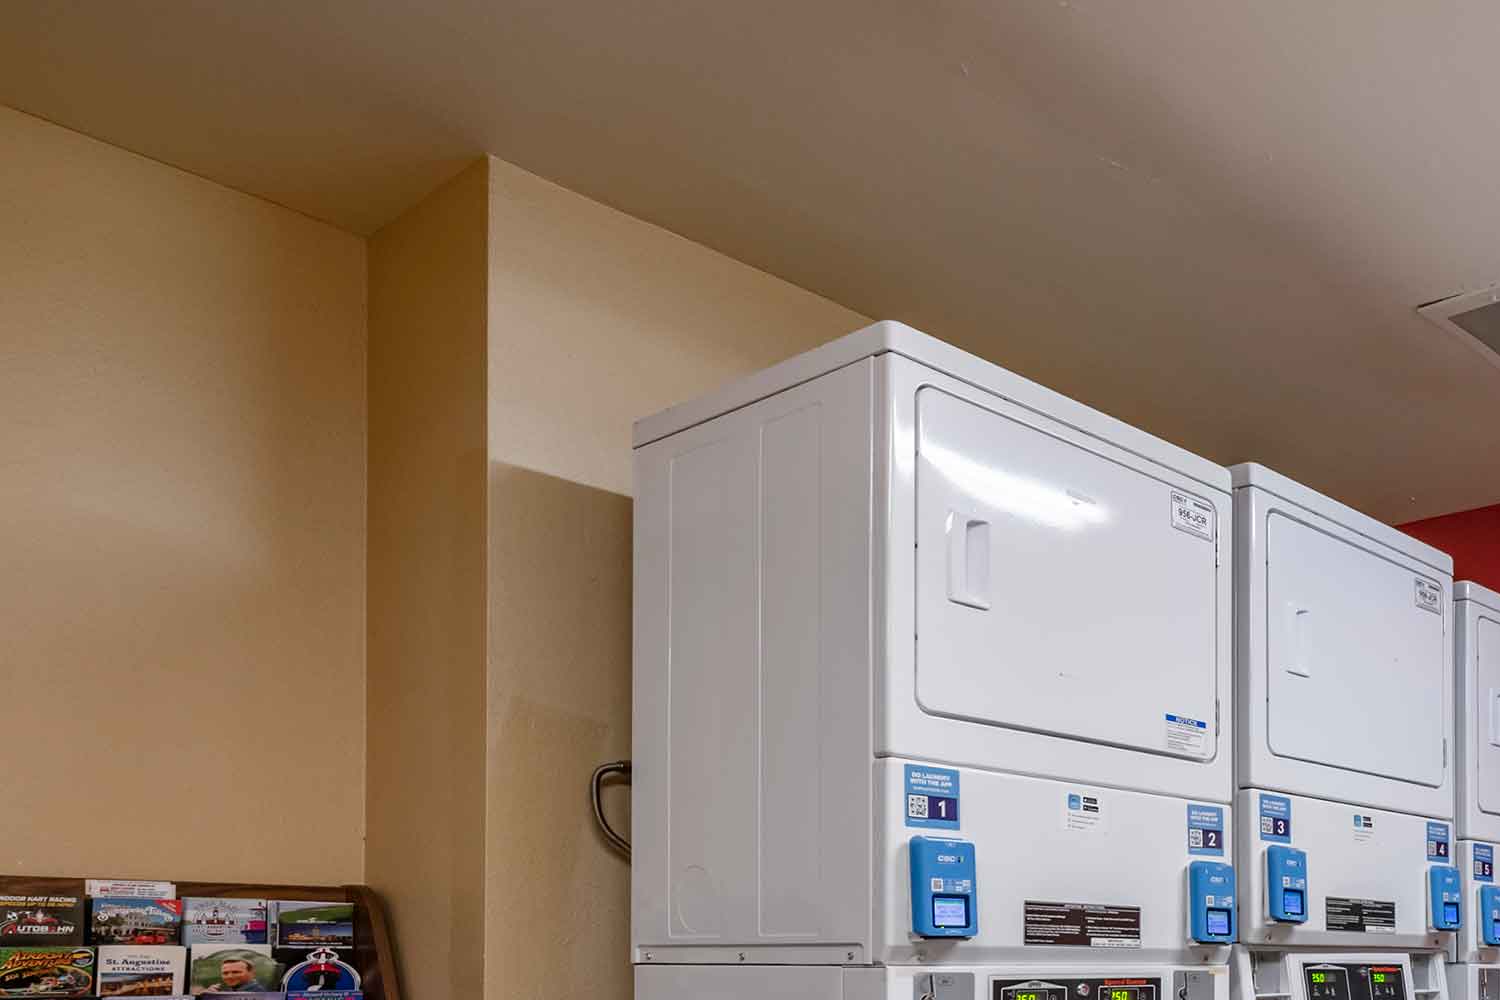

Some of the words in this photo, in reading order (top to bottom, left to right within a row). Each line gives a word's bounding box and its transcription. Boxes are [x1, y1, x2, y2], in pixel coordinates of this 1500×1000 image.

[938, 800, 947, 818] 1
[1277, 821, 1285, 834] 3
[1208, 832, 1216, 847] 2
[1439, 844, 1445, 855] 4
[1484, 863, 1490, 875] 5
